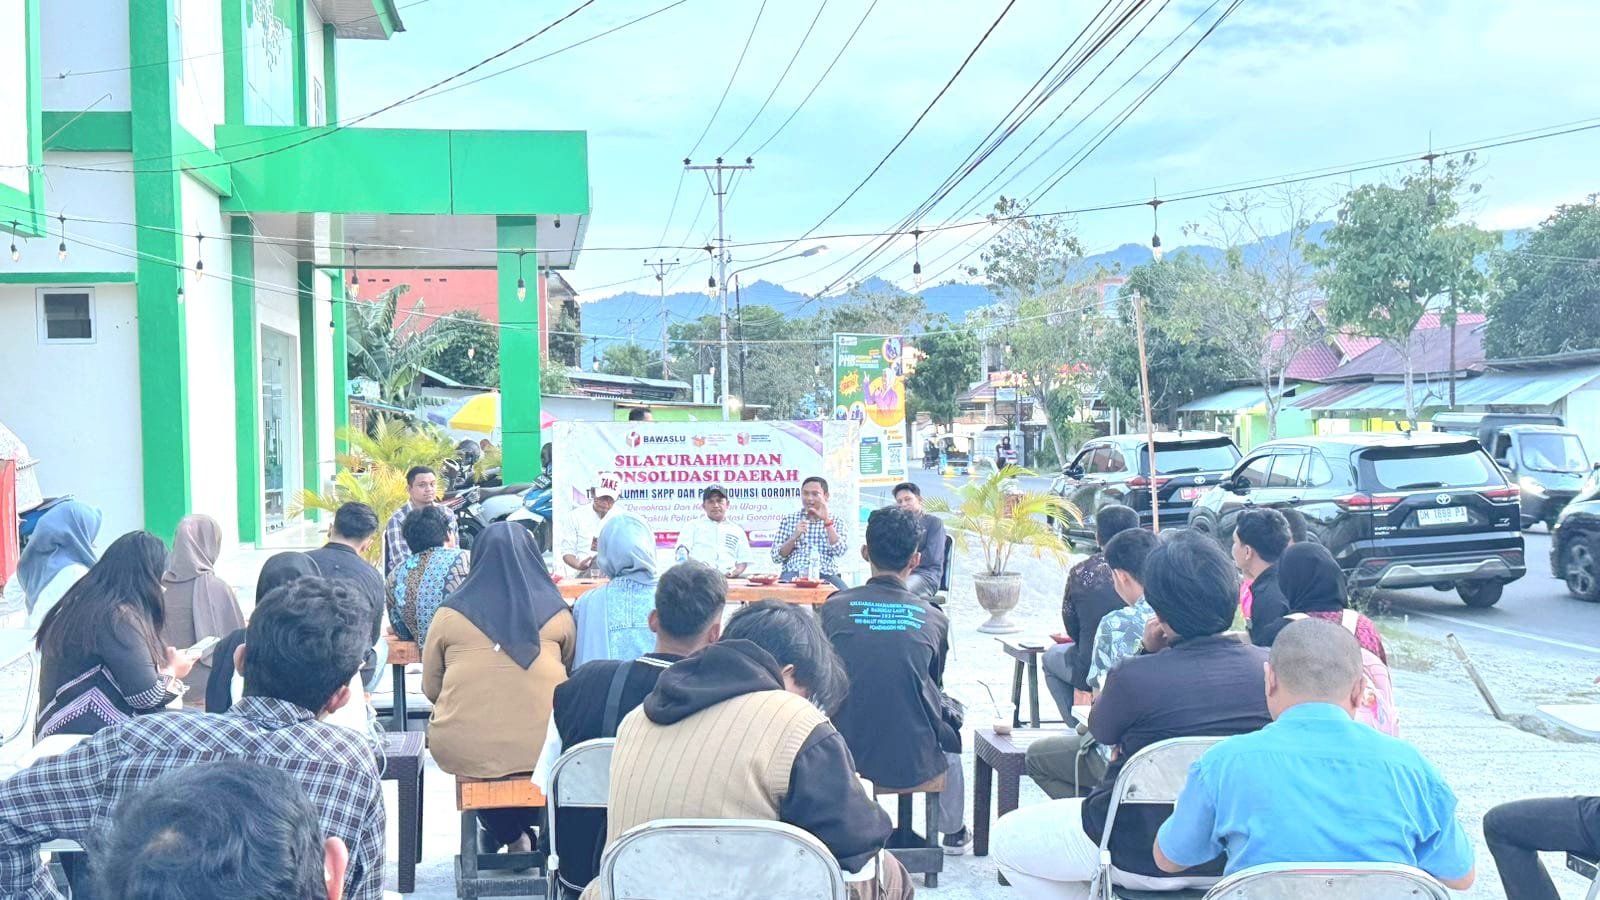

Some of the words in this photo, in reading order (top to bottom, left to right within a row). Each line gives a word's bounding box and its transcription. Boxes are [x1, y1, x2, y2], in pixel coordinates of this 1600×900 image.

[643, 435, 686, 443] BAWASLU
[615, 454, 739, 467] SILATURAHMI
[743, 453, 782, 466] DAN
[598, 471, 720, 483] NSOLIDASI
[724, 470, 799, 481] DAERAH
[600, 478, 618, 491] TAKE
[619, 489, 648, 499] LUMNI
[651, 489, 674, 499] SKPP
[677, 489, 695, 499] DAN
